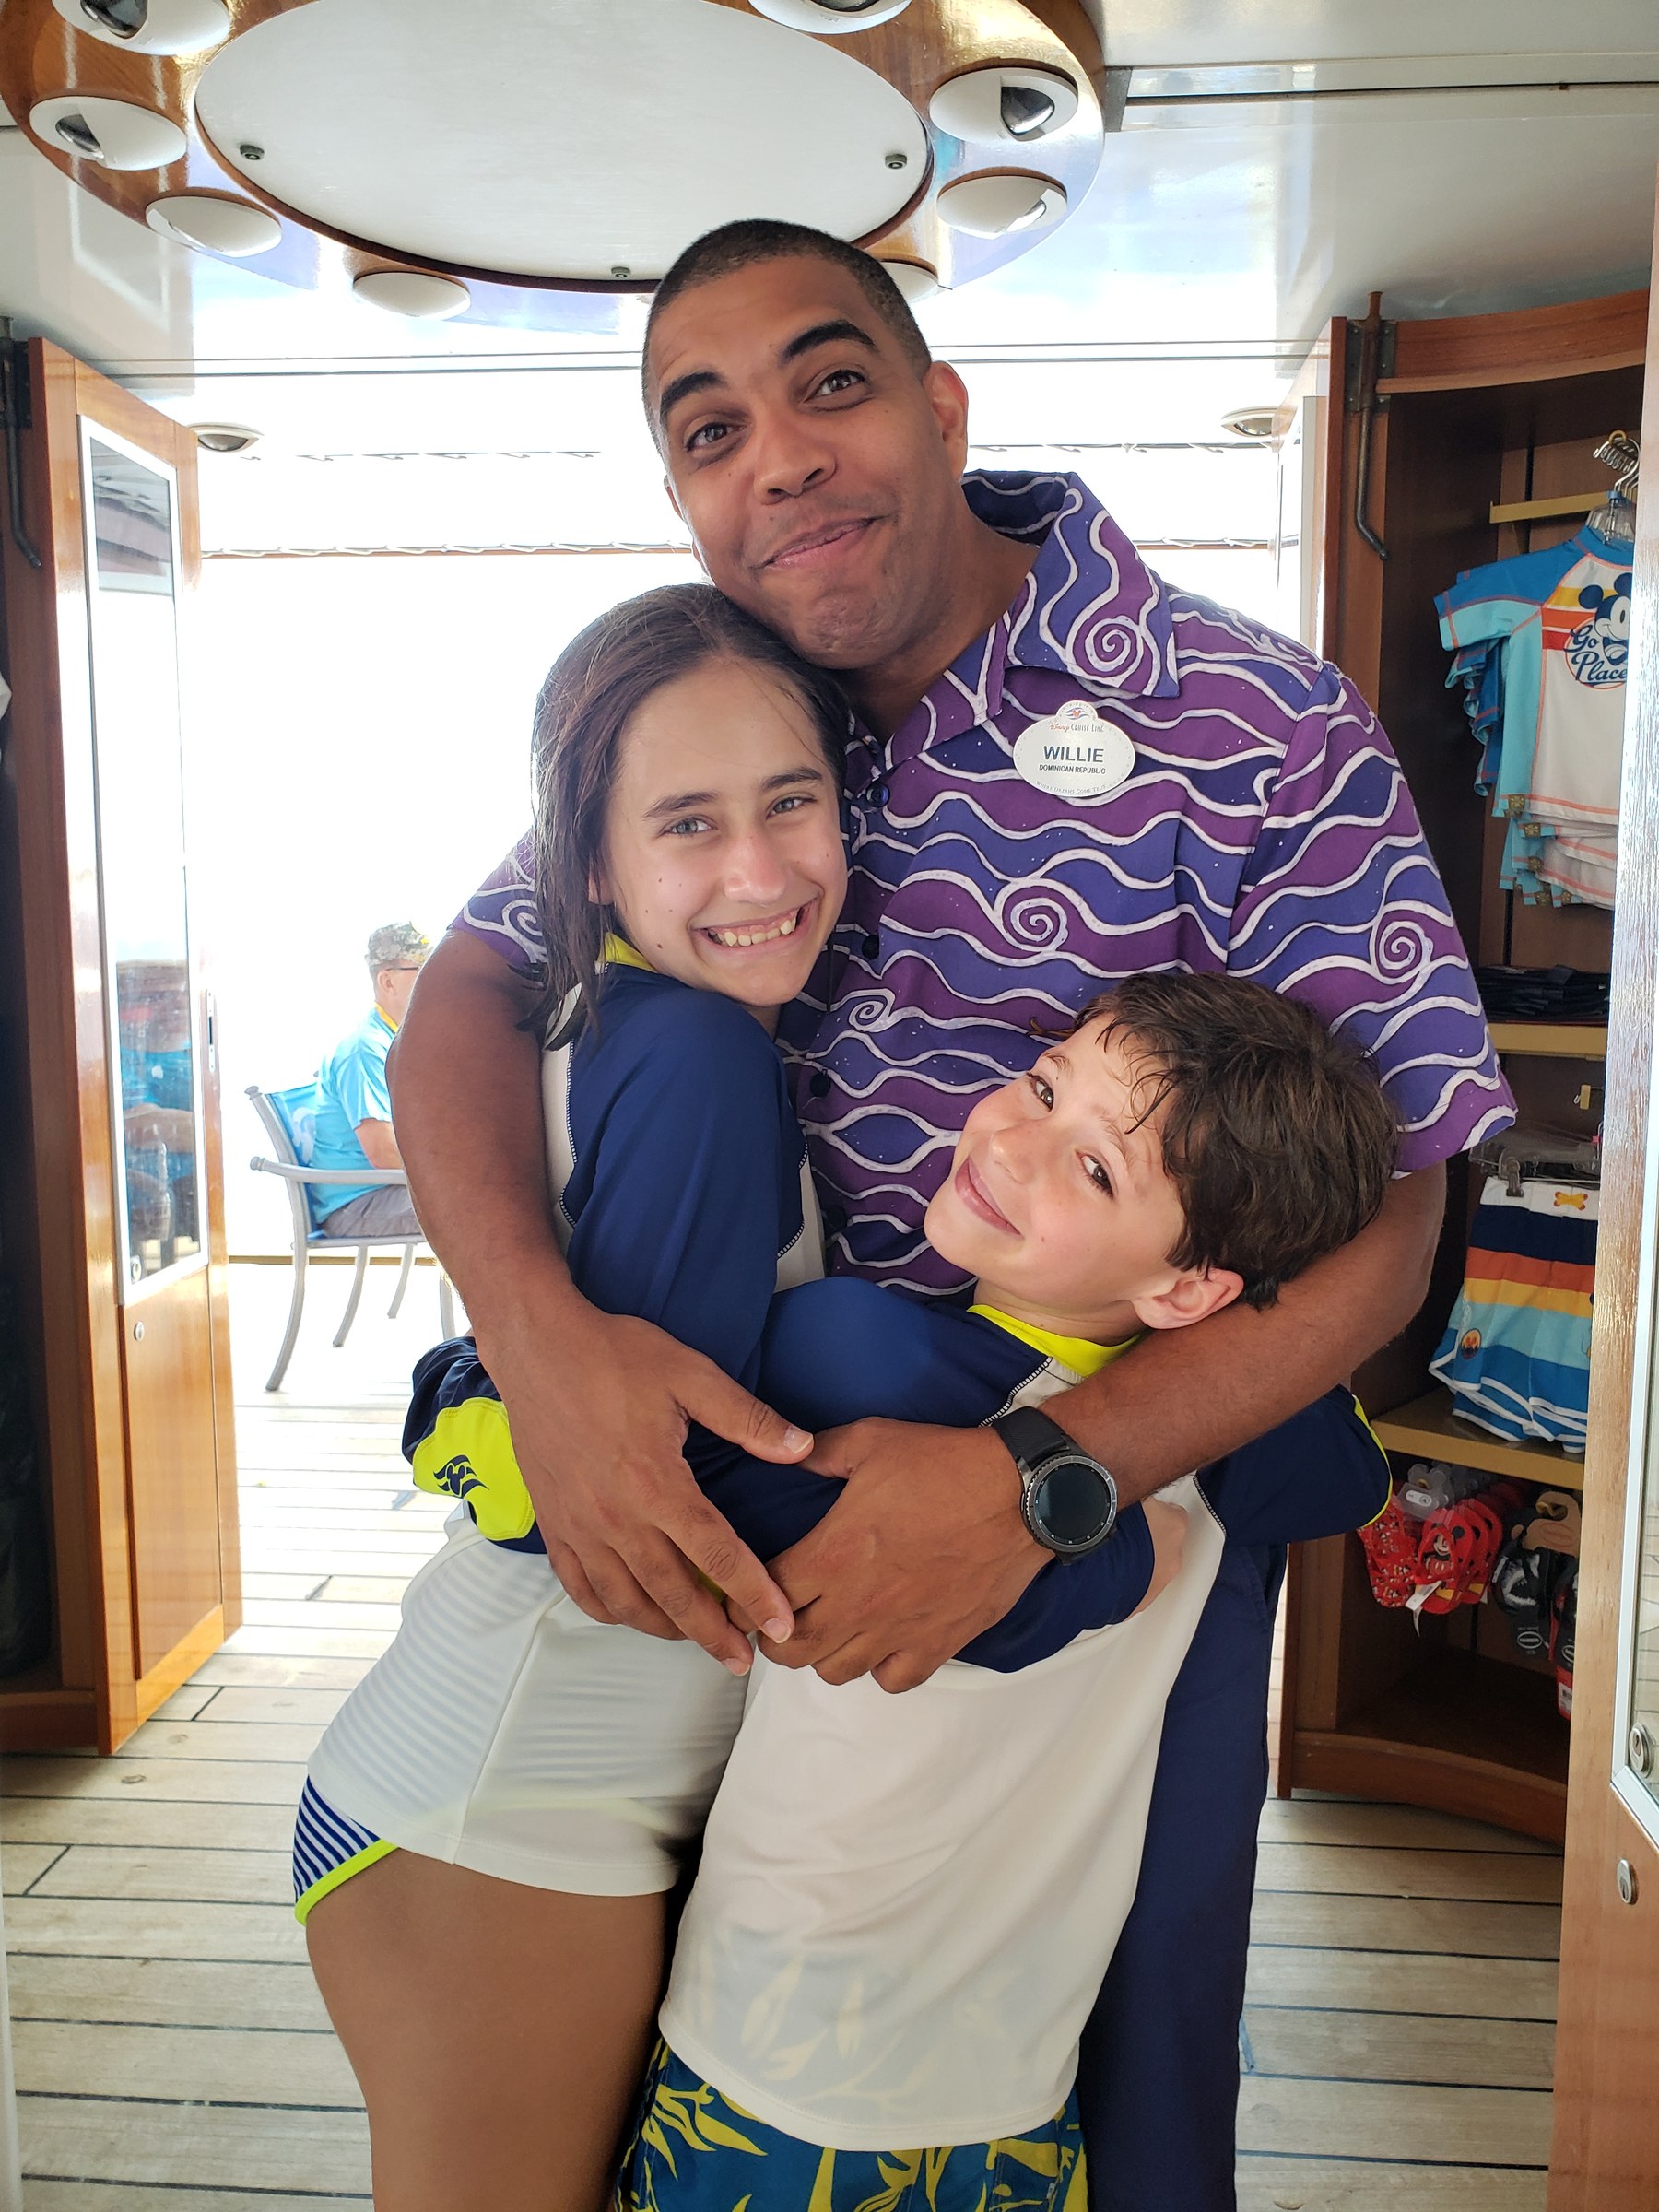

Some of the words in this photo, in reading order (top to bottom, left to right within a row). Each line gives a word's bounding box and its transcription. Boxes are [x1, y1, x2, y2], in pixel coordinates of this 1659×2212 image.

[1563, 624, 1599, 653] Go
[1050, 723, 1069, 733] Disney
[1043, 746, 1104, 763] WILLIE
[1039, 764, 1074, 772] DOMINICAN
[1075, 766, 1106, 774] REPUBLIC
